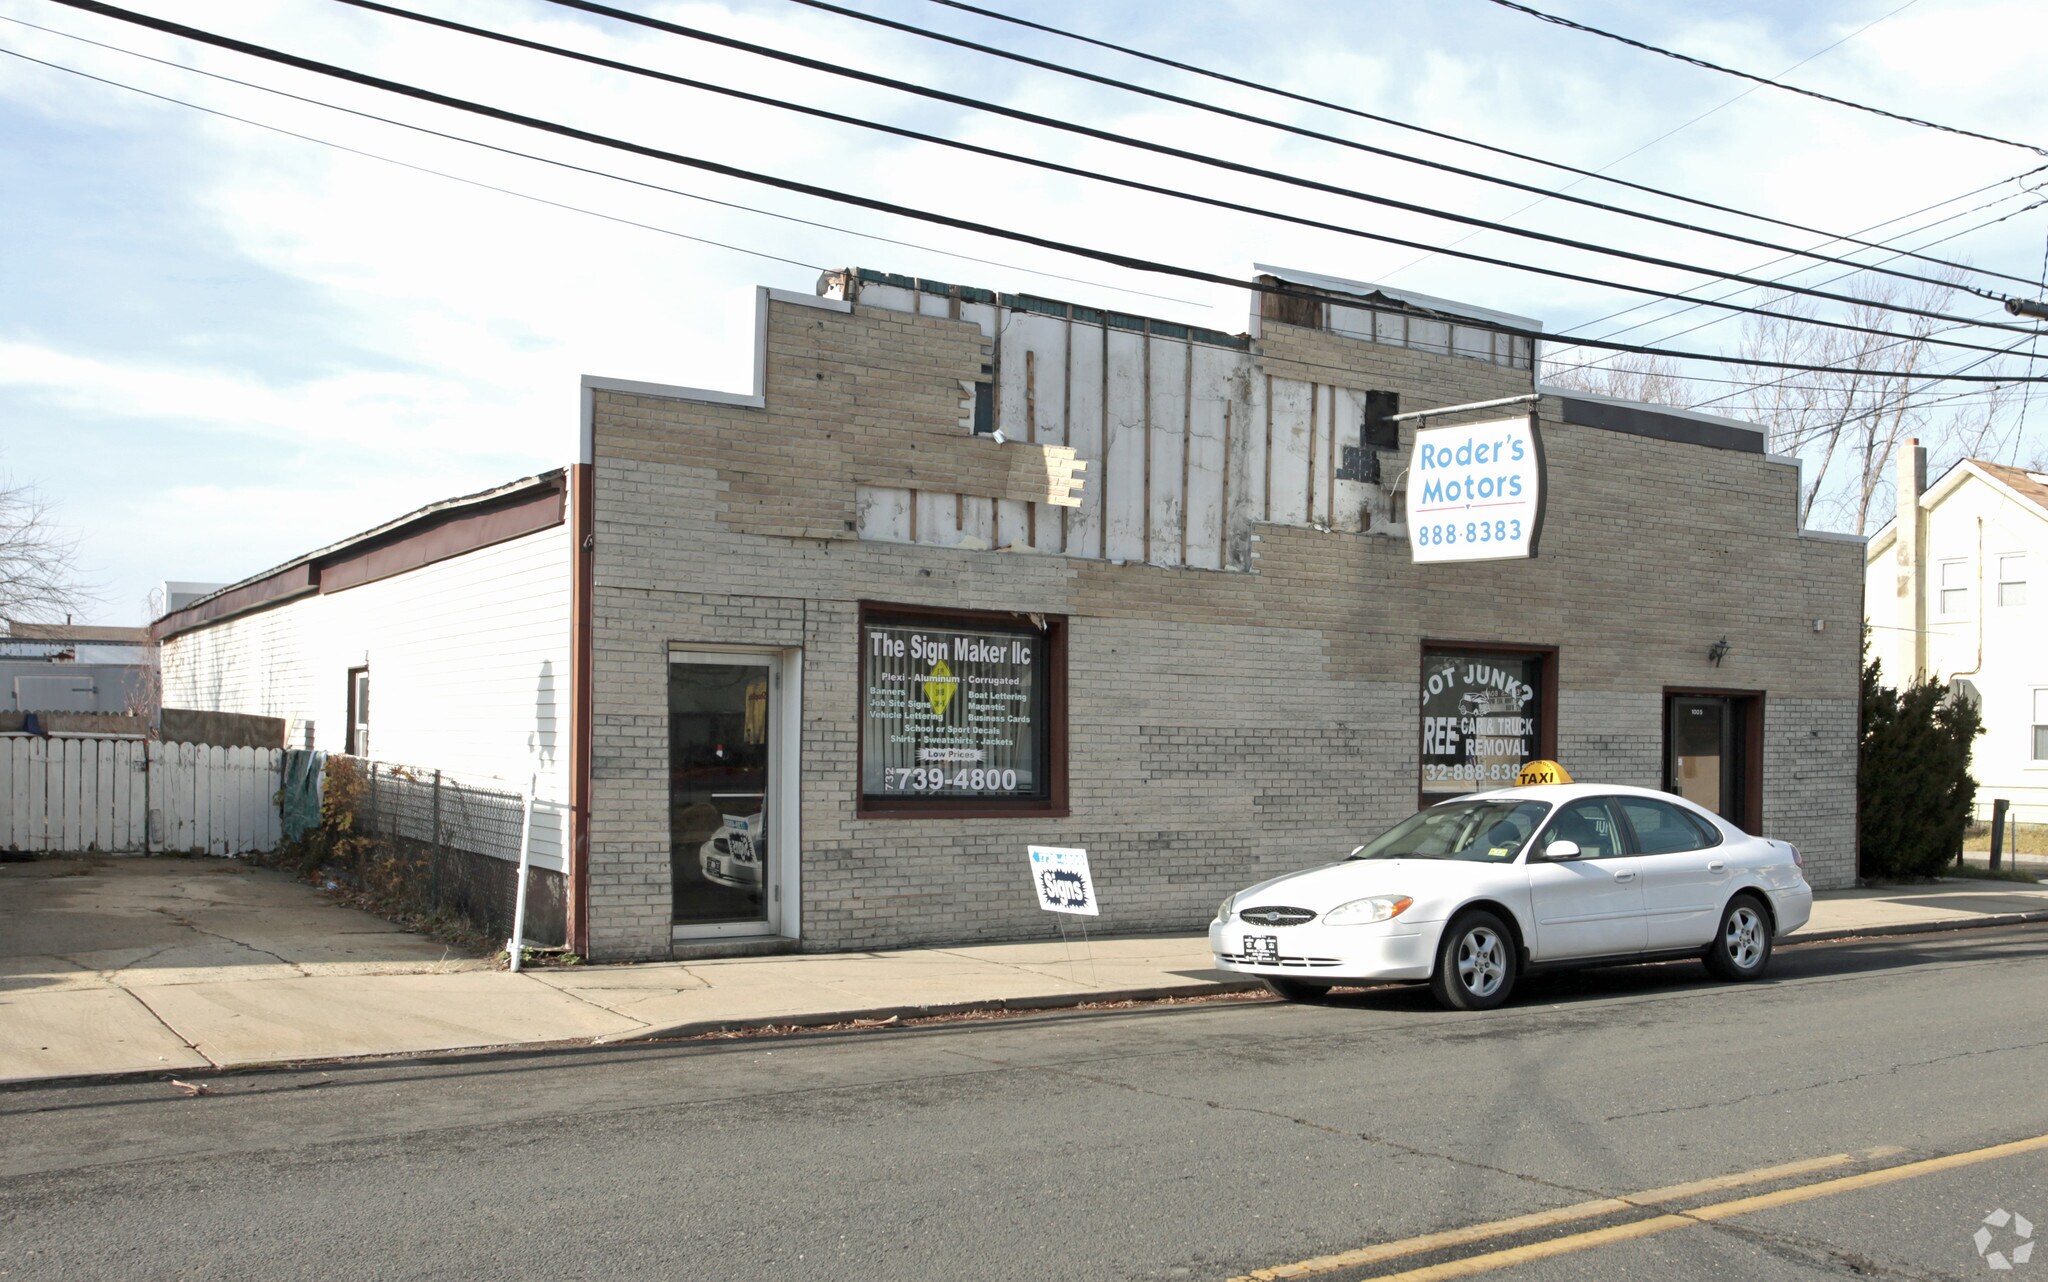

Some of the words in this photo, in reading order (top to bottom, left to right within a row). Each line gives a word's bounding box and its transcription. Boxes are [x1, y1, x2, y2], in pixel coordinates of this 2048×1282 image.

[1421, 434, 1524, 470] Roder's
[1421, 475, 1522, 504] Motors
[870, 632, 905, 657] The
[910, 634, 948, 666] Sign
[954, 637, 1007, 664] Maker
[1012, 641, 1031, 665] llc
[881, 672, 905, 682] Plexi
[914, 674, 960, 683] Aluminum
[968, 675, 1020, 687] Corrugated
[1423, 667, 1456, 706] OT
[1463, 664, 1534, 708] JUNK?
[869, 687, 906, 696] Banners
[968, 691, 988, 700] Boat
[990, 692, 1027, 702] Lettering
[869, 699, 886, 707] Job
[888, 700, 906, 708] Site
[908, 701, 932, 710] Signs
[968, 702, 1006, 712] Magnetic
[869, 710, 902, 719] Vehicle
[904, 712, 943, 722] Lettering
[968, 714, 1005, 722] Business
[1007, 715, 1031, 724] Cards
[904, 724, 934, 733] School
[947, 726, 970, 735] Sport
[972, 727, 1000, 735] Decals
[1423, 716, 1457, 755] REE
[1461, 717, 1486, 735] CAR
[1487, 718, 1495, 735] &
[1498, 718, 1533, 736] TRUCK
[890, 735, 916, 743] Shirts
[923, 736, 974, 744] Sweatshirts
[980, 738, 1014, 746] Jackets
[1465, 738, 1529, 756] REMOVAL
[948, 751, 975, 759] Prices
[885, 767, 894, 791] 732
[895, 768, 1017, 791] 739-4800
[1520, 773, 1553, 784] TAXI
[1043, 871, 1083, 906] Signs
